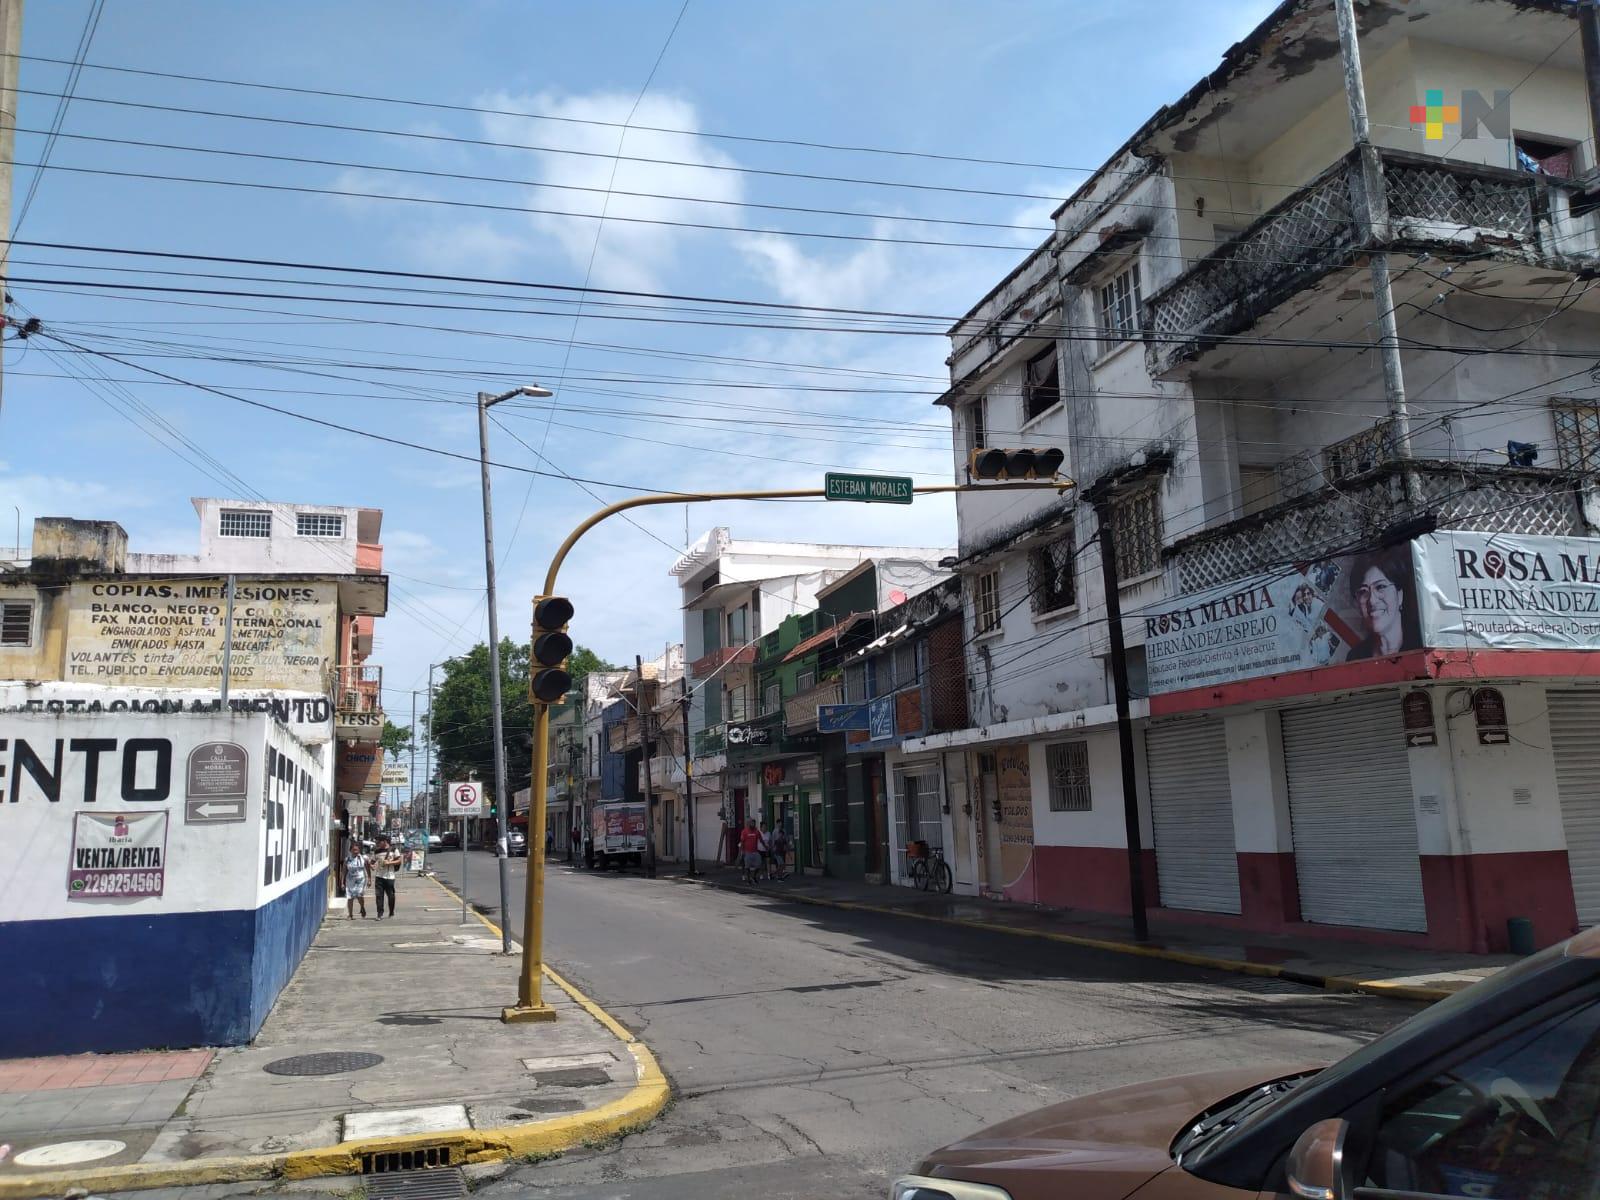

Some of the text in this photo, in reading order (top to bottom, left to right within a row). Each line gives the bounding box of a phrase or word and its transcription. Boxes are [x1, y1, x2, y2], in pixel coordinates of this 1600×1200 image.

[829, 479, 908, 497] ESTEBAN MORALES
[1454, 548, 1554, 581] ROSA
[91, 584, 179, 598] COPIAS,
[1460, 585, 1600, 612] HERNÁNDEZ
[91, 603, 158, 614] BLANCO,
[166, 604, 220, 616] NEGRO
[91, 614, 119, 625] FAX
[128, 615, 194, 626] NACIONAL
[219, 617, 323, 629] ITERNACONAL
[1145, 607, 1197, 639] ROSA
[1463, 620, 1524, 636] Diputada
[100, 626, 171, 637] ENGARGOLADOS
[1147, 615, 1277, 659] HERNÁNDEZ ESPEJO
[111, 638, 168, 650] ENMICADOS
[173, 640, 206, 651] HASTA
[71, 651, 137, 663] VOLANTES
[143, 652, 175, 664] tinta
[214, 654, 251, 665] VRDE
[70, 665, 95, 676] TEL.
[97, 665, 148, 677] PUBLICO
[341, 712, 380, 726] TESIS
[0, 738, 172, 803] NTO
[76, 846, 161, 869] VENTA/RENTA
[84, 872, 162, 893] 2293254566
